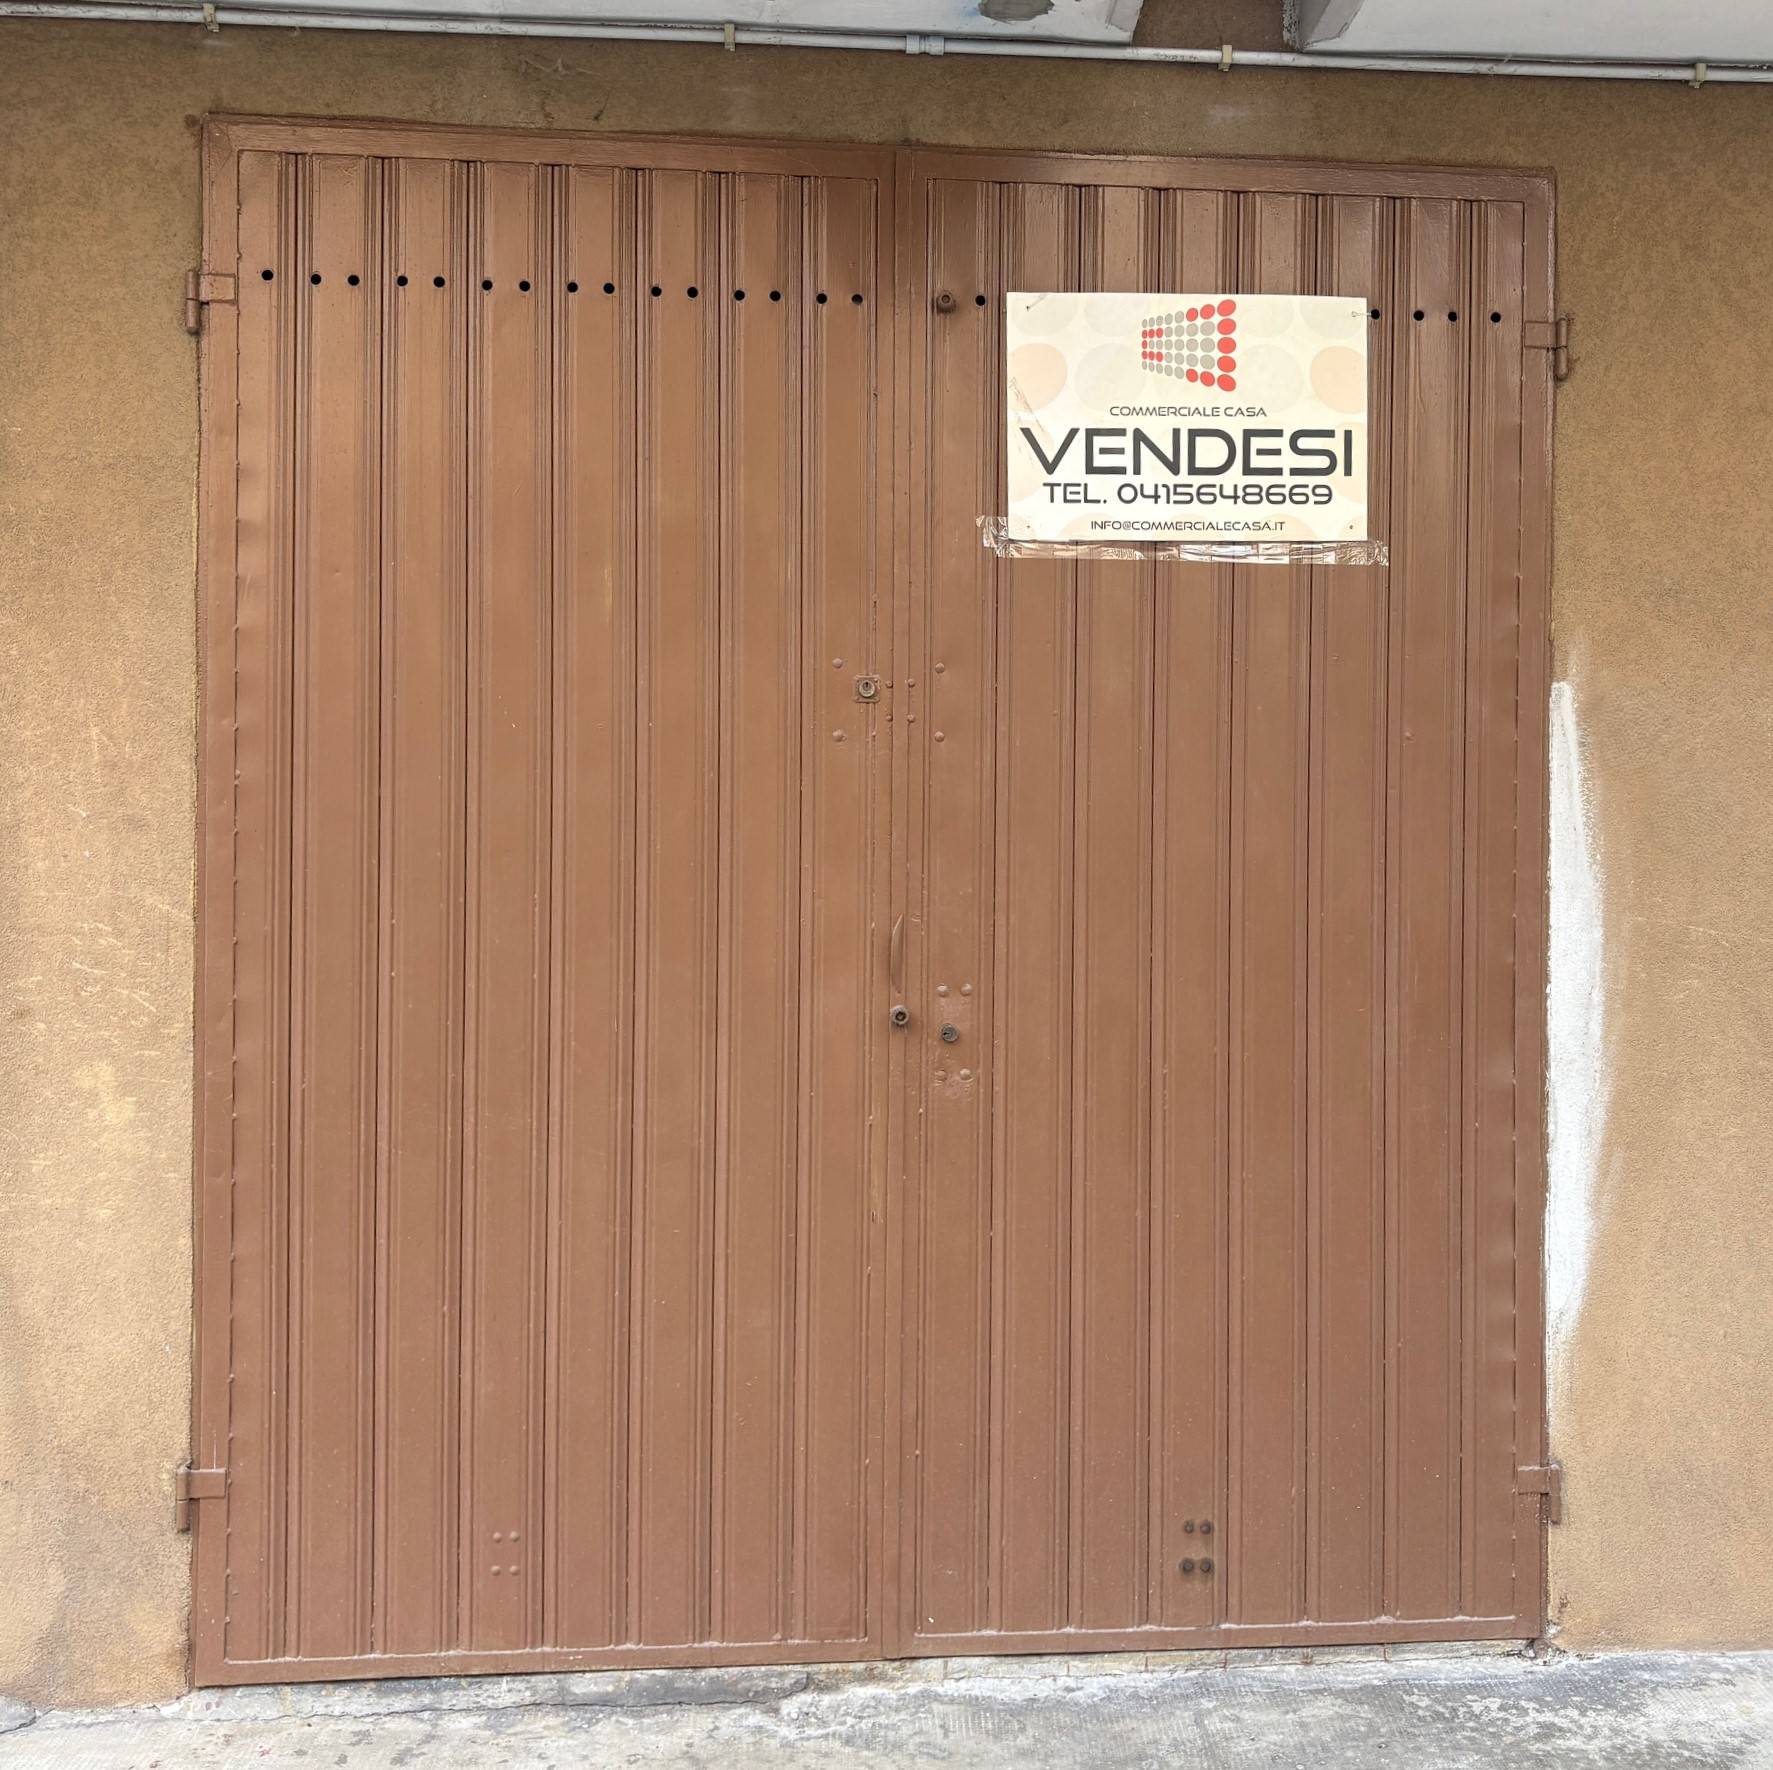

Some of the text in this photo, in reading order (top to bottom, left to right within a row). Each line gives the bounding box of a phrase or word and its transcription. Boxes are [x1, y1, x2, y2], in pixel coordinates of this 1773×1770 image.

[1109, 406, 1267, 417] COMMERCIALE CASA
[1019, 427, 1353, 477] VENDESI
[1042, 482, 1333, 505] TEL. 0415648669
[1091, 520, 1285, 531] INFO@COMMERCIALECASA.IT
